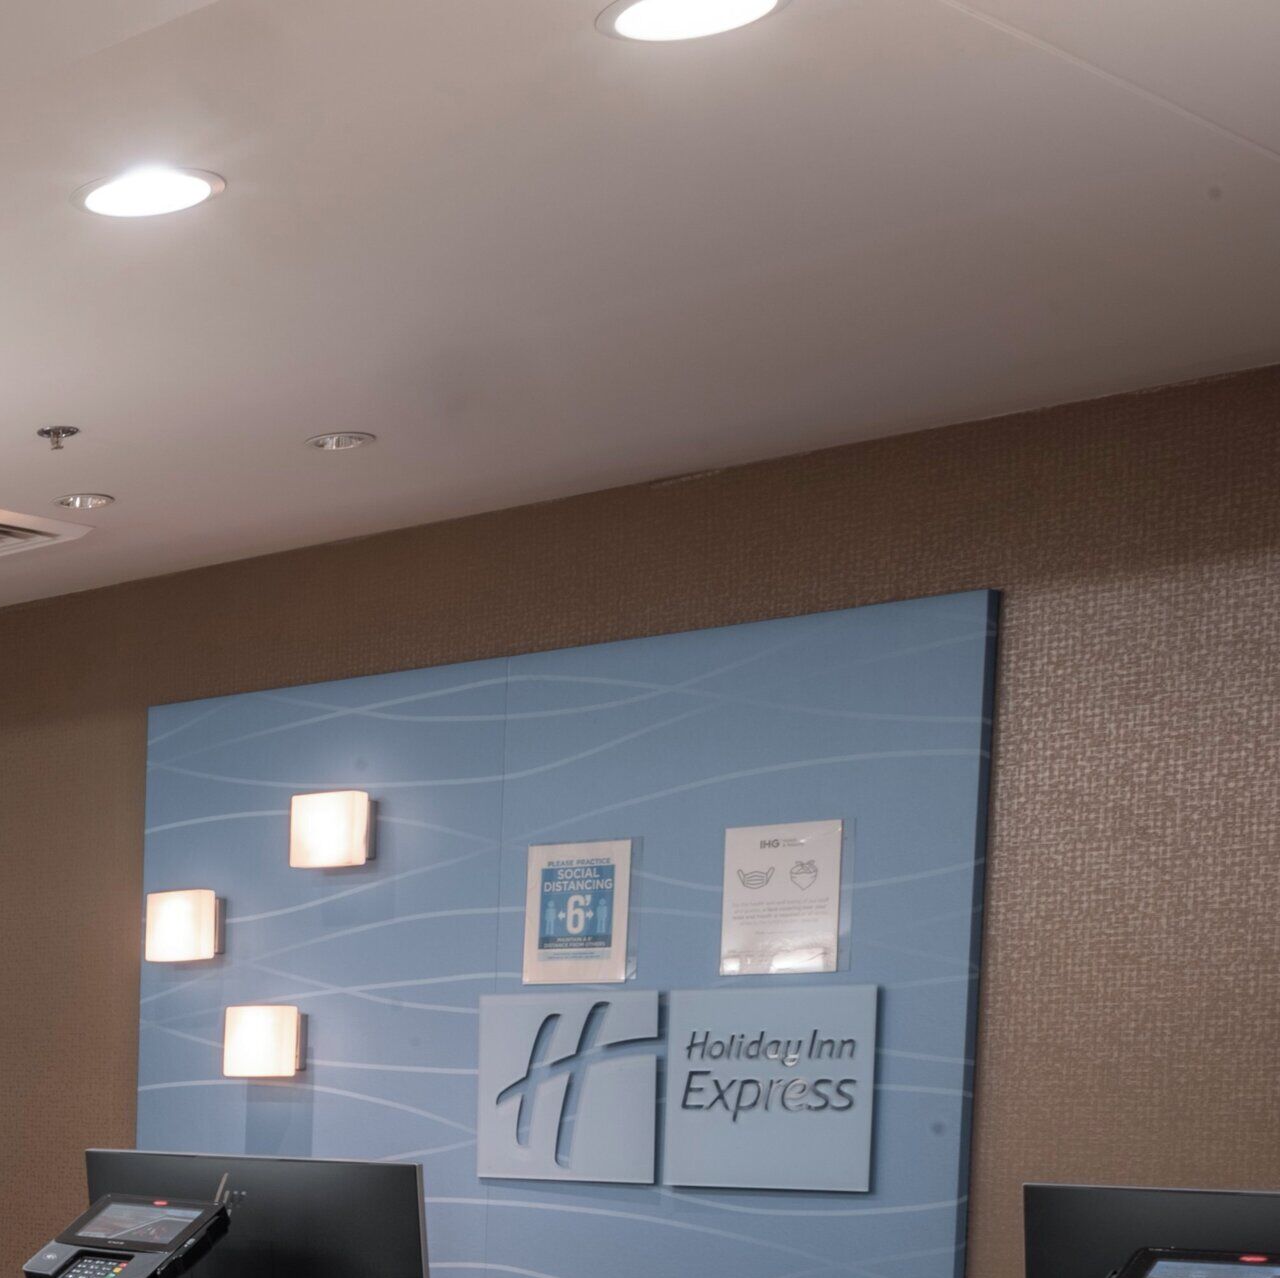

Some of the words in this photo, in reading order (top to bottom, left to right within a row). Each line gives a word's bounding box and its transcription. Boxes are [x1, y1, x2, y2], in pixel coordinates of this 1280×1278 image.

[759, 839, 780, 849] IHG
[576, 857, 611, 866] PRACTICE
[557, 867, 600, 880] SOCIAL
[543, 879, 613, 893] DISTANCING
[685, 1029, 803, 1068] Holiday
[809, 1028, 857, 1061] Inn
[680, 1069, 858, 1122] Express
